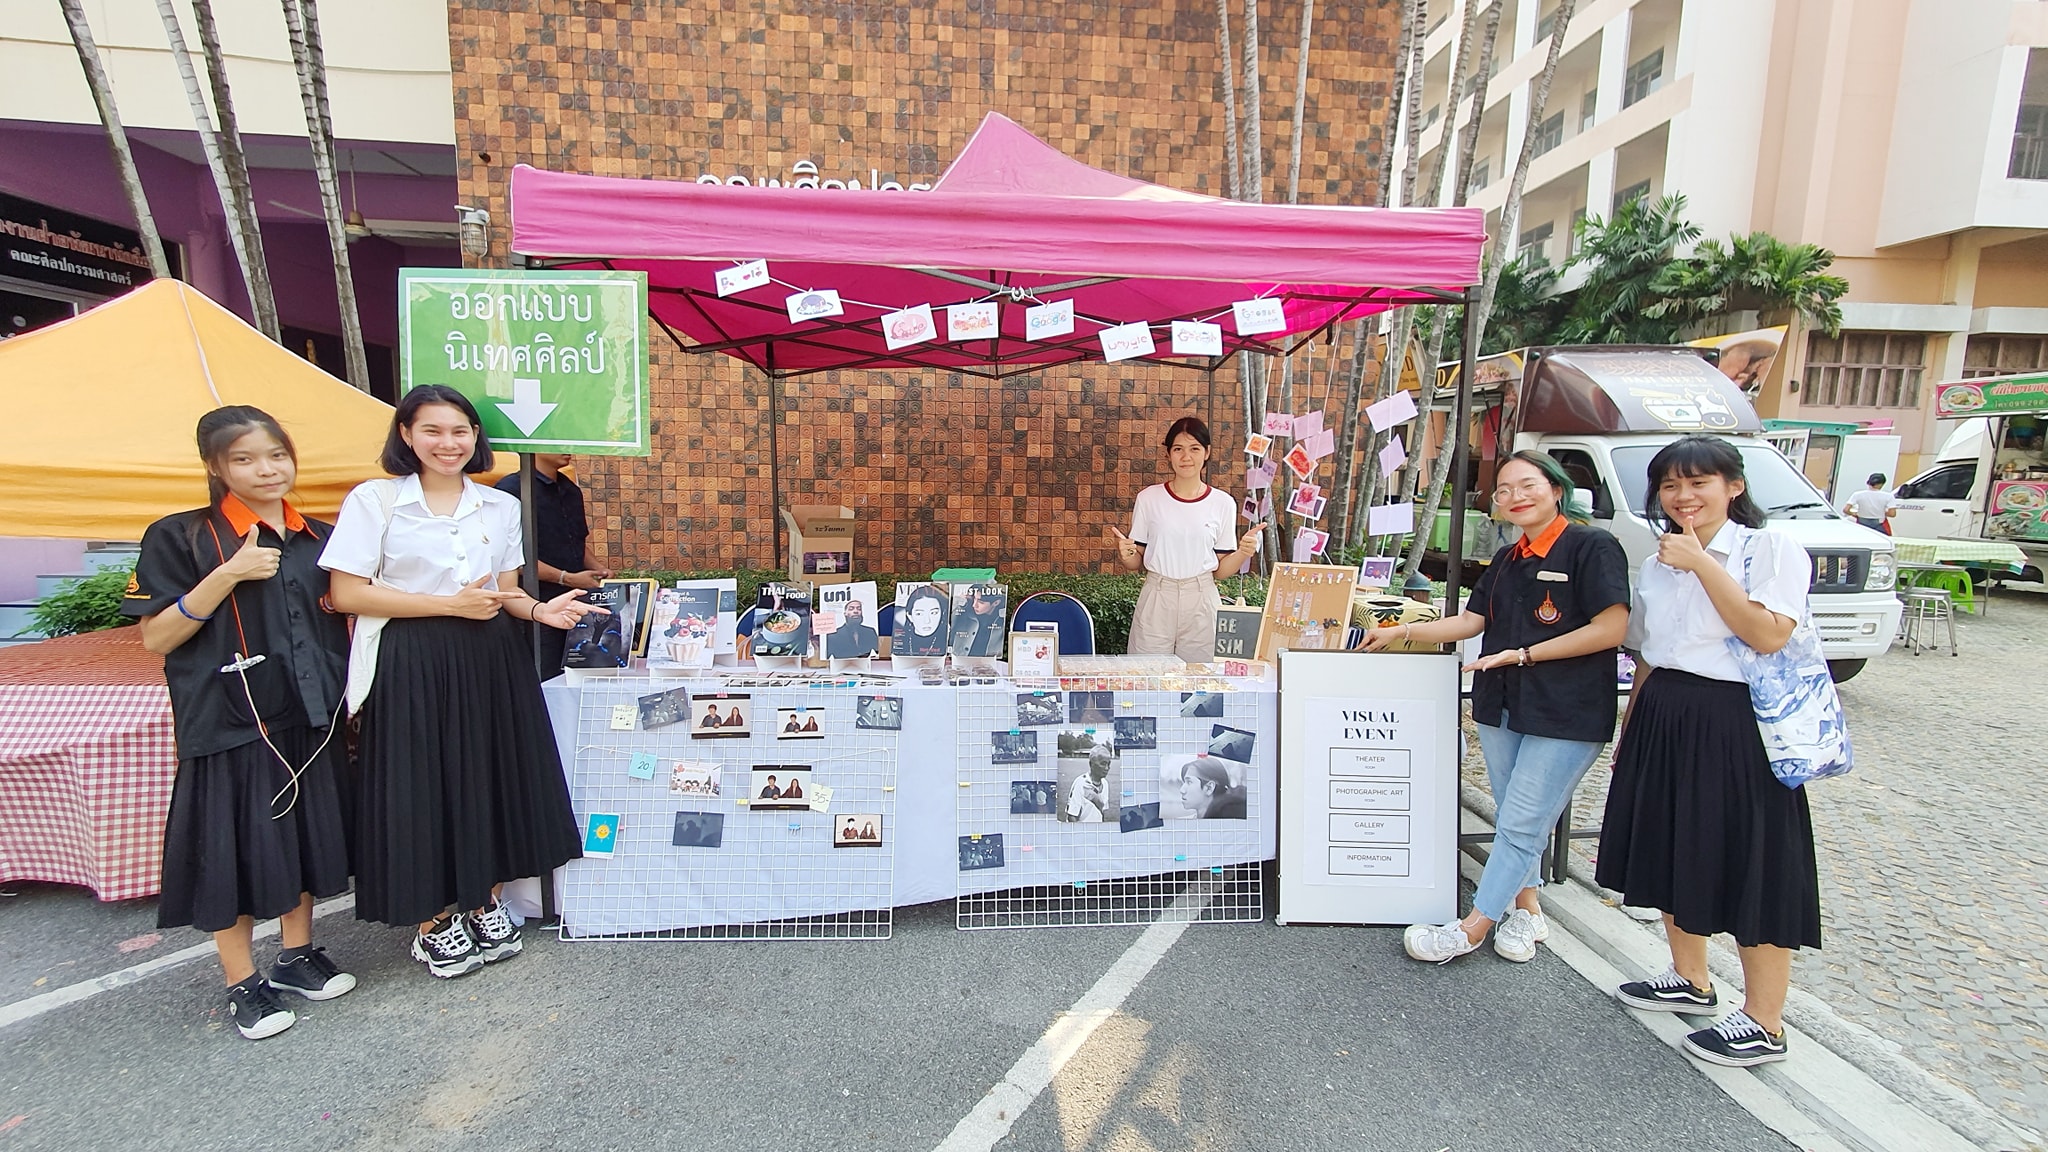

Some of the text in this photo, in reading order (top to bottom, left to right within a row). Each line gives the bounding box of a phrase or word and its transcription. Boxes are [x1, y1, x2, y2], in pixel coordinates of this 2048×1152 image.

[10, 249, 131, 286] คณะศิลปกรรมศาสตร์
[451, 292, 592, 322] ออกแบบ
[444, 330, 605, 374] นิเทศศิลป์
[762, 587, 785, 596] THAI
[785, 592, 807, 600] FOOD
[823, 586, 851, 602] uni
[1217, 617, 1237, 634] RE
[1216, 638, 1244, 655] SIN
[1342, 710, 1400, 724] VISUAL
[1344, 727, 1397, 740] EVENT
[1355, 755, 1385, 763] THEATER
[1336, 788, 1388, 796] PHOTOGRAPHIC
[1354, 821, 1384, 829] GALLERY
